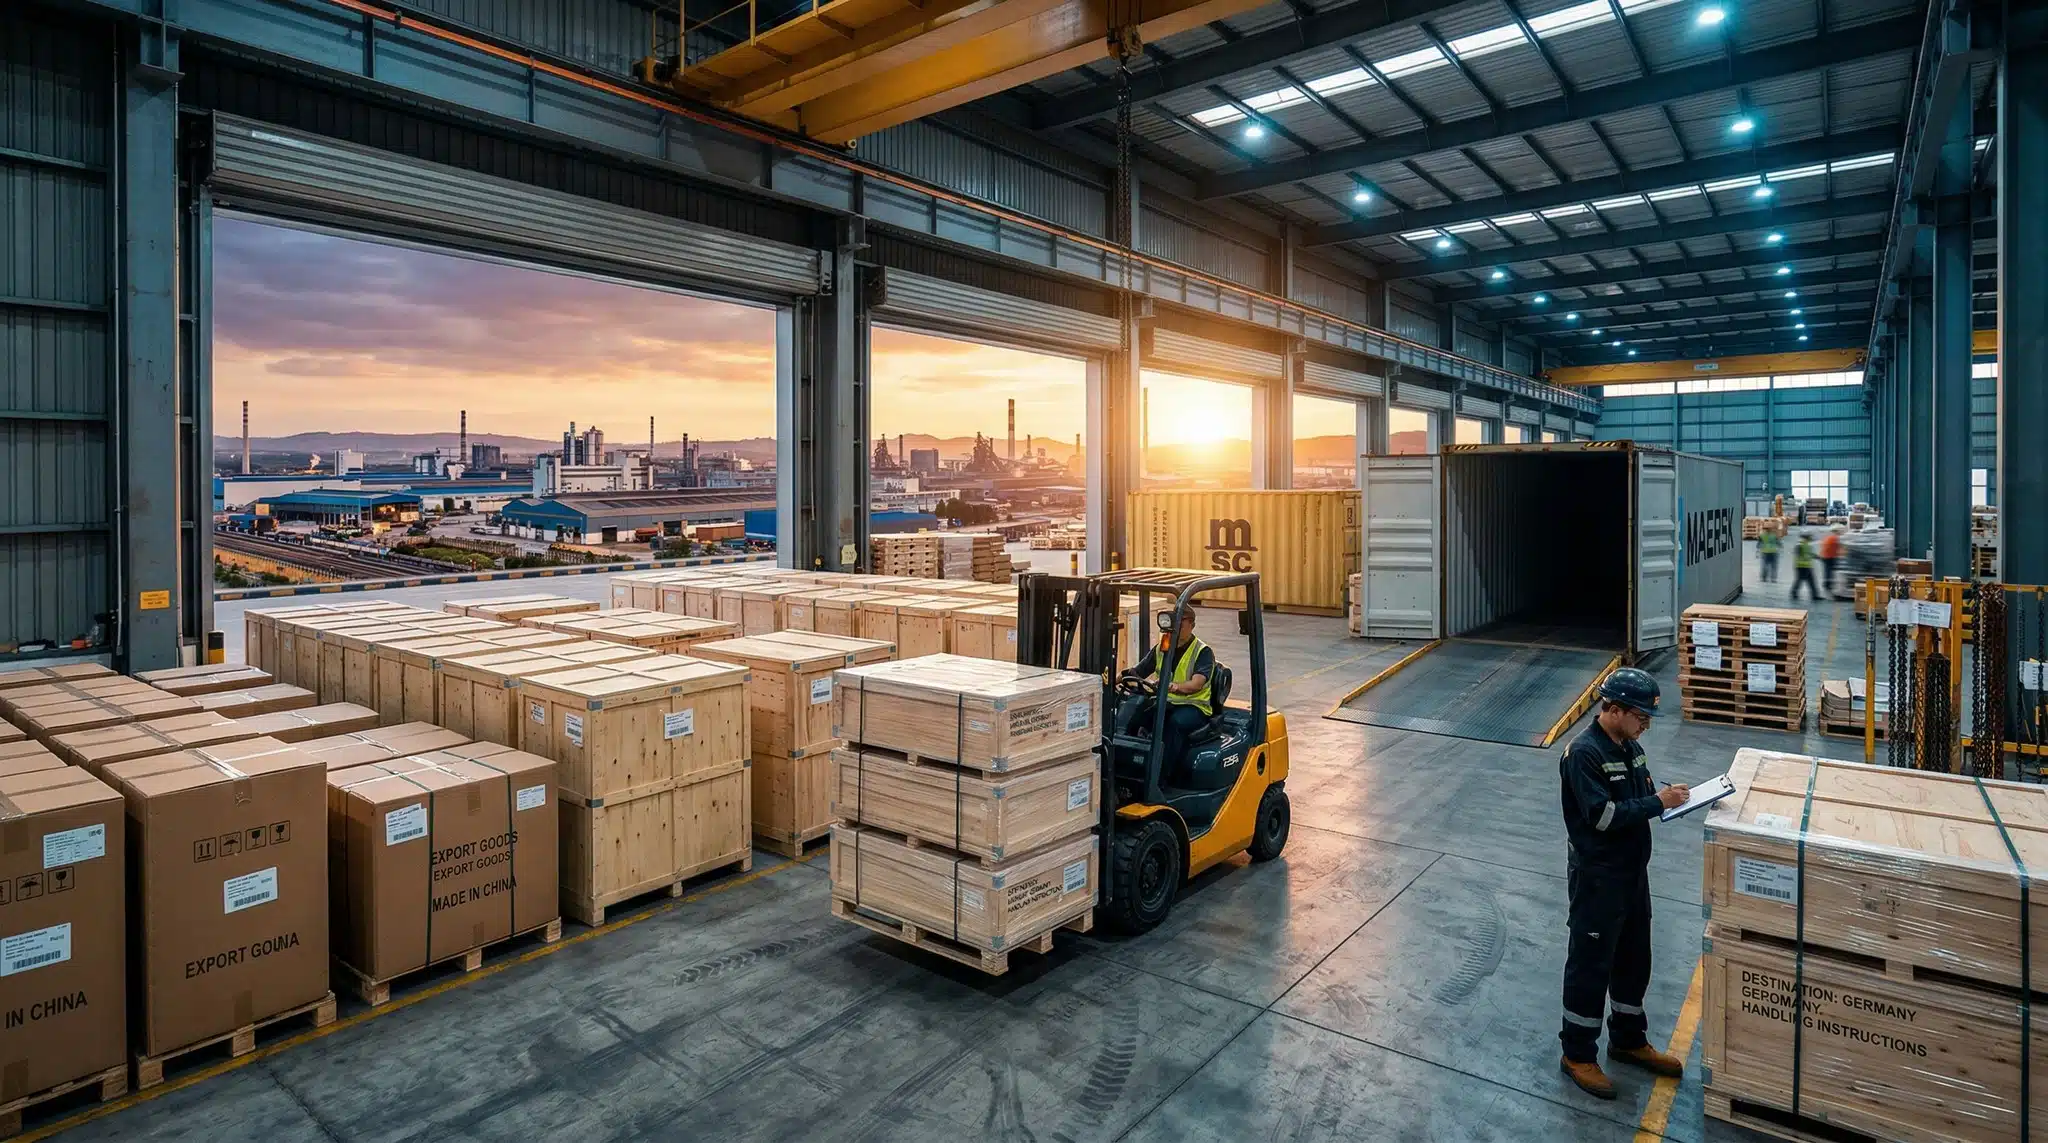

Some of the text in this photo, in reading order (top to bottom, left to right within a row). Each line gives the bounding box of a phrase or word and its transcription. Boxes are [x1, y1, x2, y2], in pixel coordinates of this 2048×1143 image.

[1687, 507, 1734, 567] MAERSK
[432, 831, 518, 865] EXPORT GOODS
[434, 861, 474, 881] EXPORT
[432, 874, 517, 912] MADE IN CHINA
[185, 946, 247, 979] EXPORT
[5, 990, 88, 1029] IN CHINA
[1742, 970, 1917, 1022] DESTINATION: GERMANY
[1817, 1019, 1927, 1057] INSTRUCTIONS
